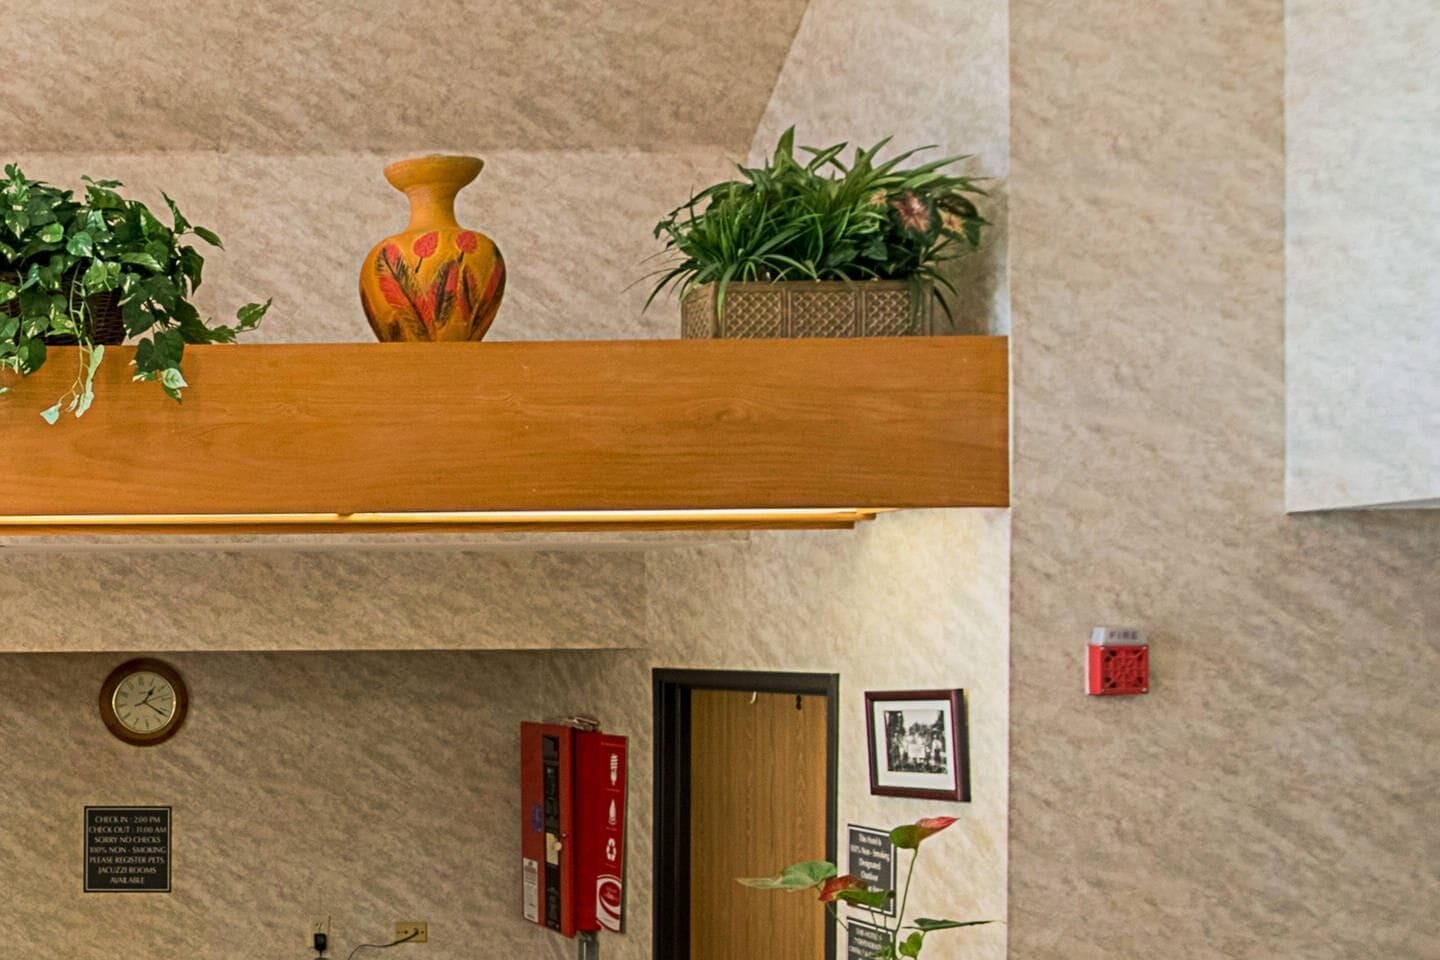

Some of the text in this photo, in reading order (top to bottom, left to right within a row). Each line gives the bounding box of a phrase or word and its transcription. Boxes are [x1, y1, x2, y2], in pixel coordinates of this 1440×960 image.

[1109, 630, 1138, 640] FIRE
[94, 836, 118, 844] SORRY
[132, 846, 166, 854] SMOKING
[98, 866, 127, 874] JACUZZI
